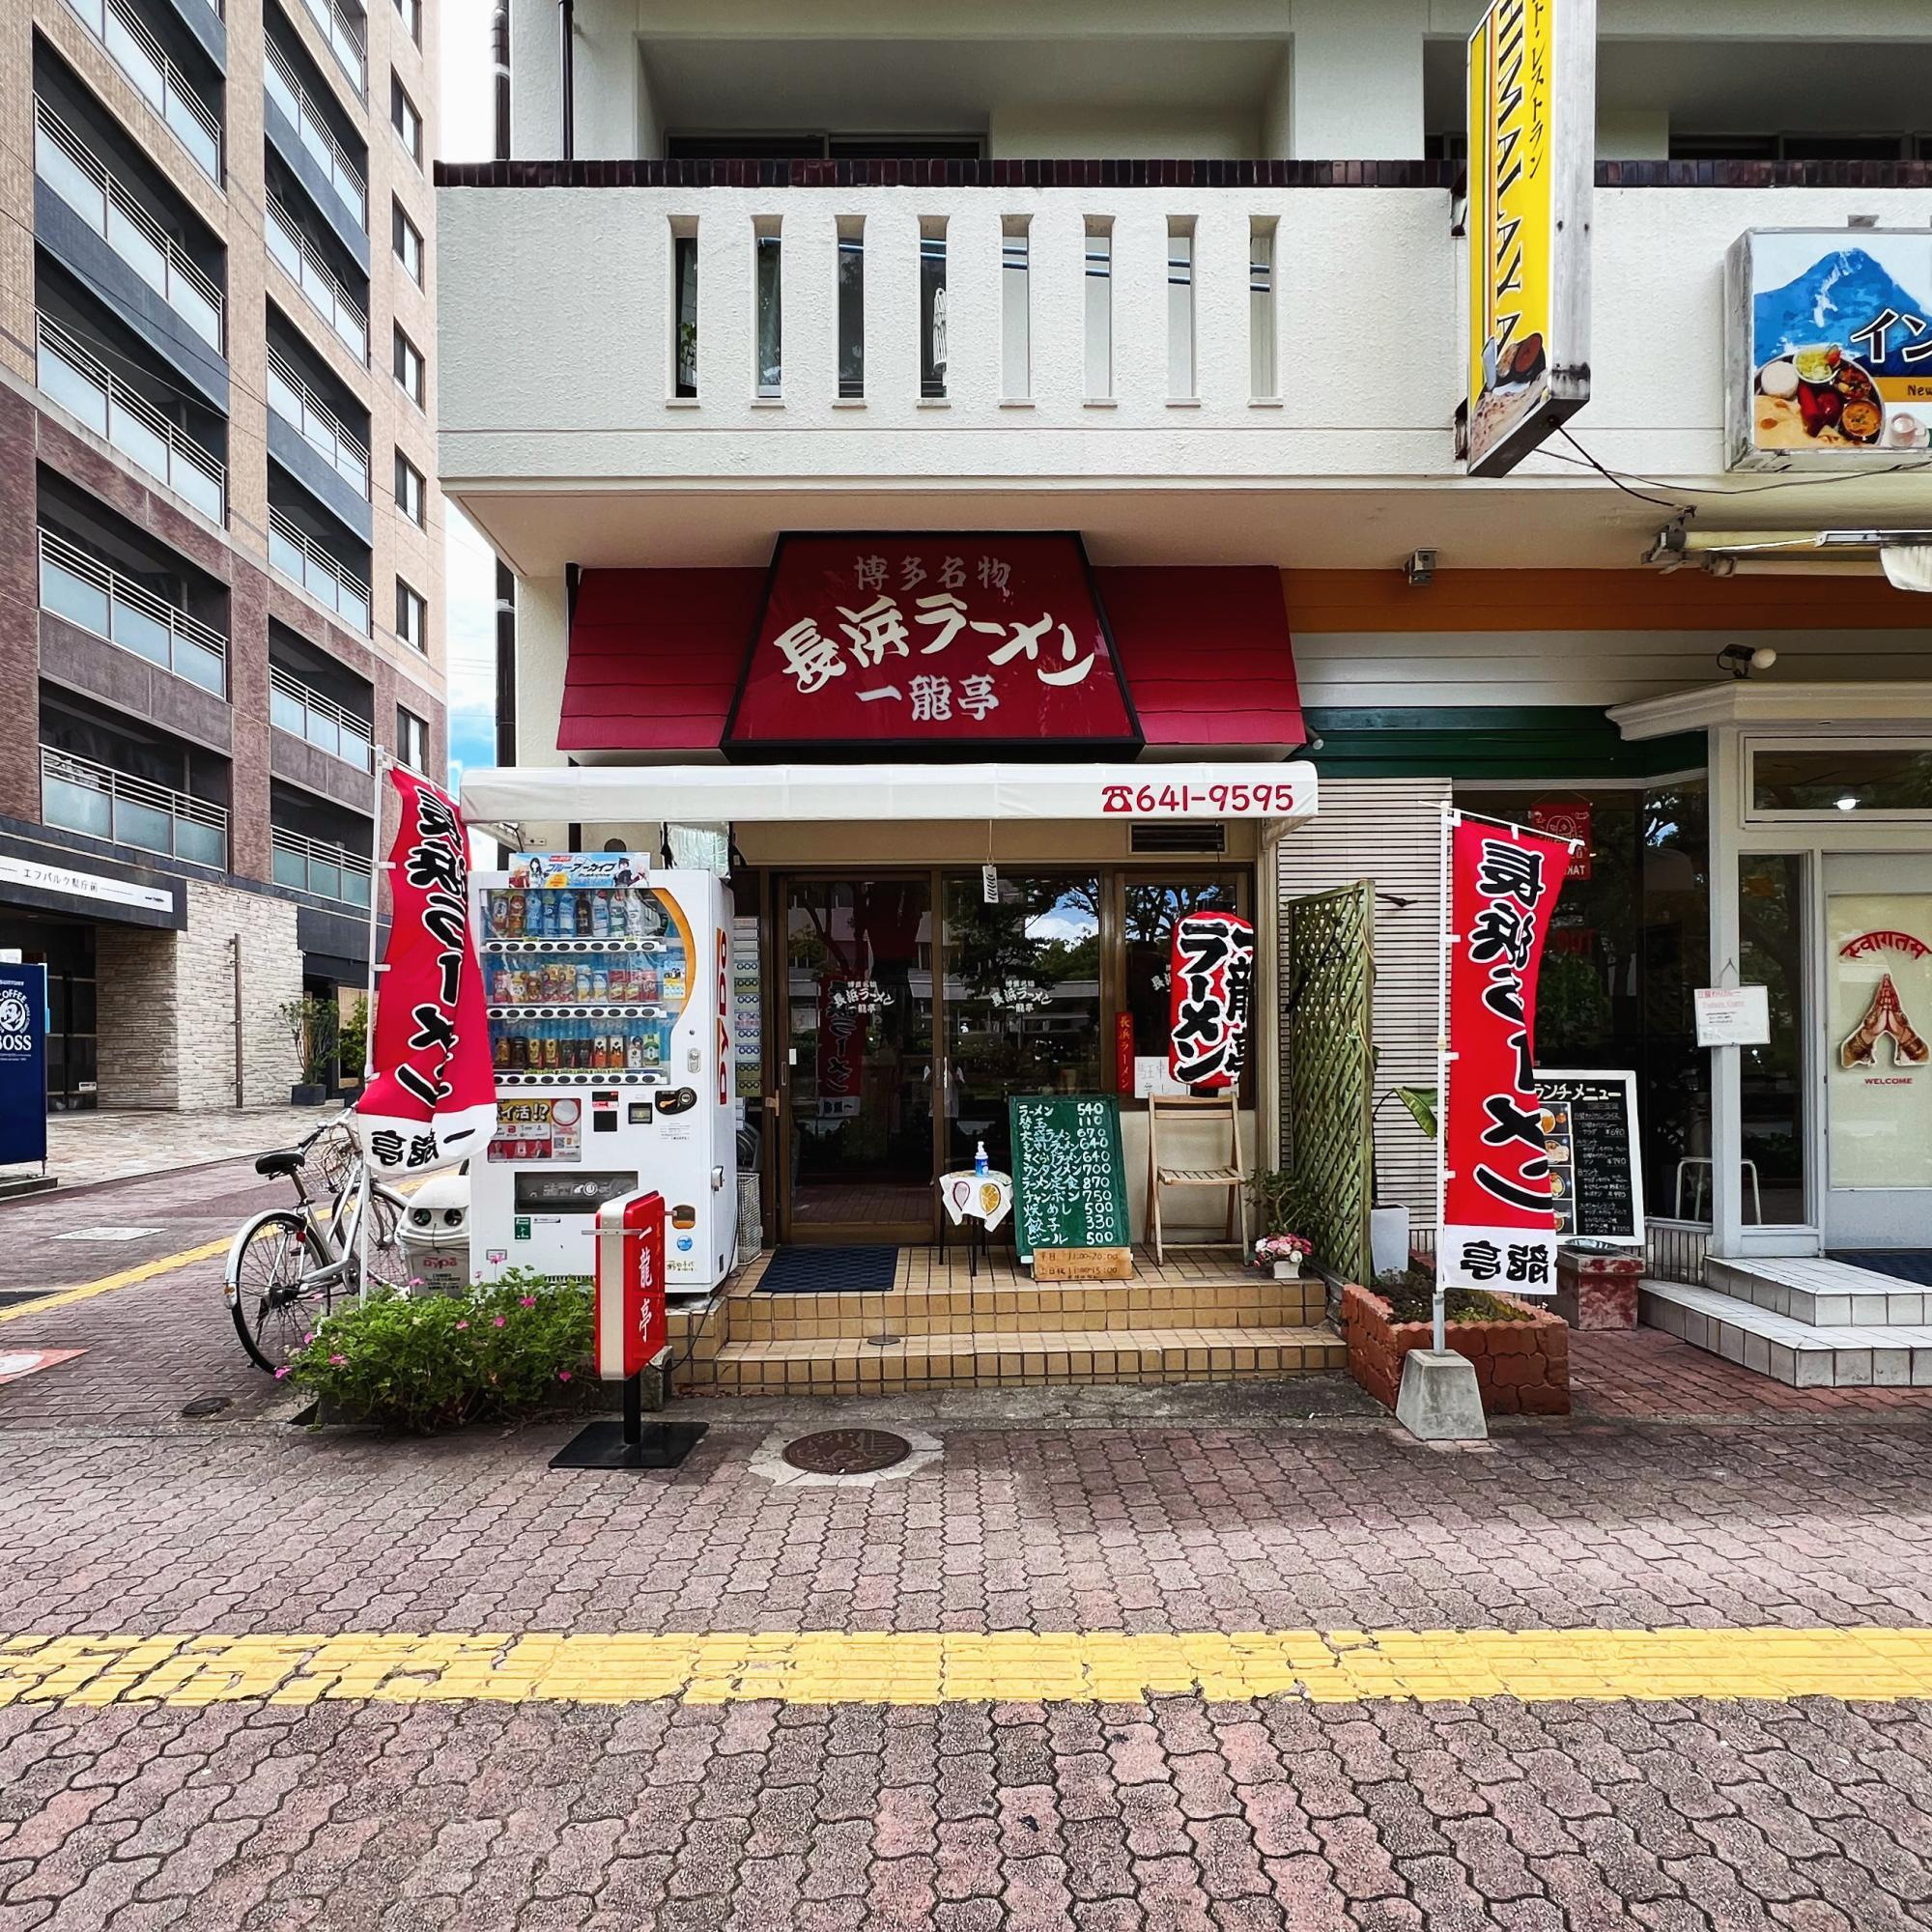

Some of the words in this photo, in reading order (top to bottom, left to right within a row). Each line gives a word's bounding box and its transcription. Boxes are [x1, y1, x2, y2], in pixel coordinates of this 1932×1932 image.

[854, 554, 1012, 591] 博多名物
[773, 591, 1095, 695] 長浜ラーメン
[855, 674, 1001, 722] 一龍亭
[1136, 783, 1294, 813] 641-9595
[834, 987, 895, 1009] 長浜ラーメン
[990, 987, 1053, 1009] 長浜ラーメン
[1173, 919, 1233, 1085] ラーメン
[0, 1035, 32, 1051] OSS
[1118, 1014, 1132, 1090] 長浜ラーメン
[496, 1099, 550, 1122] イ活!?
[1018, 1104, 1054, 1117] ラーメン
[1077, 1103, 1104, 1116] 540
[1079, 1116, 1102, 1126] 110
[1076, 1128, 1106, 1138] 670
[1079, 1137, 1109, 1150] 640
[1082, 1151, 1110, 1163] 640
[1082, 1163, 1112, 1175] 700
[1022, 1175, 1081, 1191] ラーメン定食
[1082, 1177, 1111, 1190] 870
[1082, 1190, 1112, 1202] 750
[1084, 1202, 1114, 1215] 500
[1023, 1217, 1061, 1235] 餃子
[1085, 1215, 1114, 1230] 330
[1027, 1232, 1069, 1246] ビール
[1086, 1232, 1114, 1245] 500
[639, 1226, 654, 1344] 一龍亭
